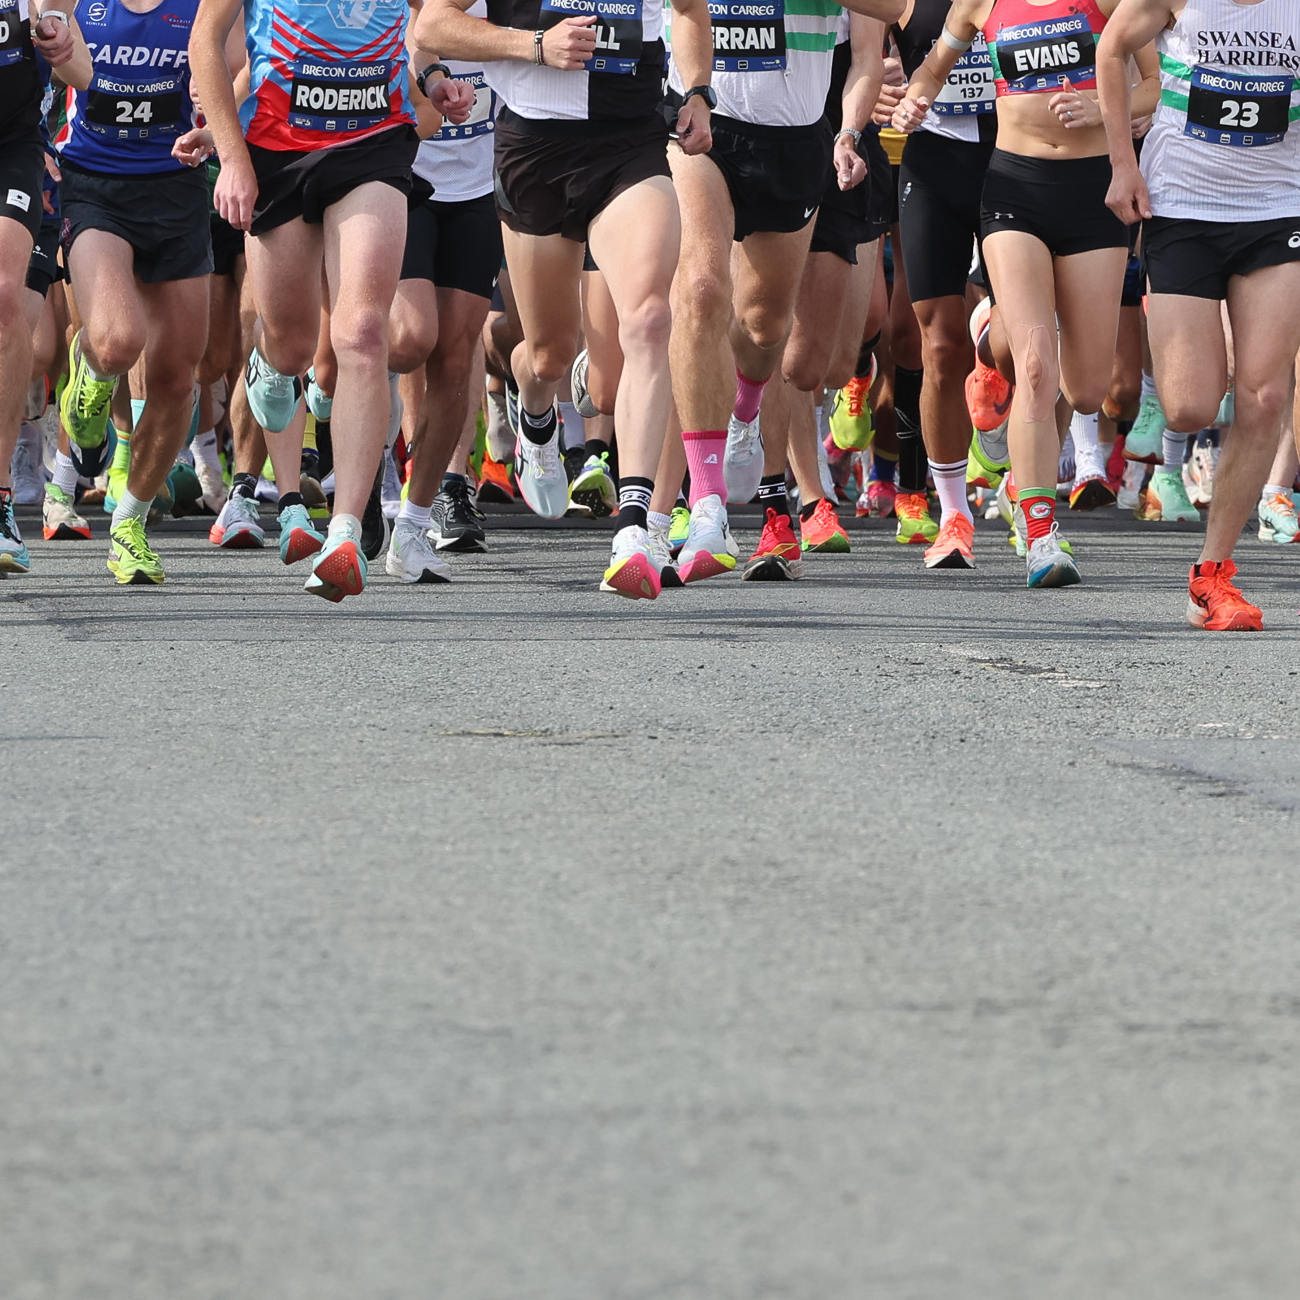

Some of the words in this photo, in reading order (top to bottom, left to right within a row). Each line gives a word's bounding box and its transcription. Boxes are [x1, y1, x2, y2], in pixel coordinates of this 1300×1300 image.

[597, 2, 636, 15] CARREG
[731, 4, 775, 16] CARREG
[1003, 26, 1042, 41] BRECON
[1044, 20, 1082, 34] CARREG
[1197, 31, 1296, 51] SWANSEA
[1014, 41, 1081, 72] EVANS
[1197, 49, 1300, 71] HARRIERS
[302, 64, 346, 78] BRECON
[348, 65, 385, 78] CARREG
[97, 78, 135, 93] BRECON
[137, 80, 175, 93] CARREG
[960, 87, 984, 99] 137
[1200, 74, 1242, 91] BRECON
[1244, 81, 1285, 93] CARREG
[295, 84, 388, 111] RODERICK
[115, 101, 153, 123] 24
[1219, 100, 1260, 128] 23
